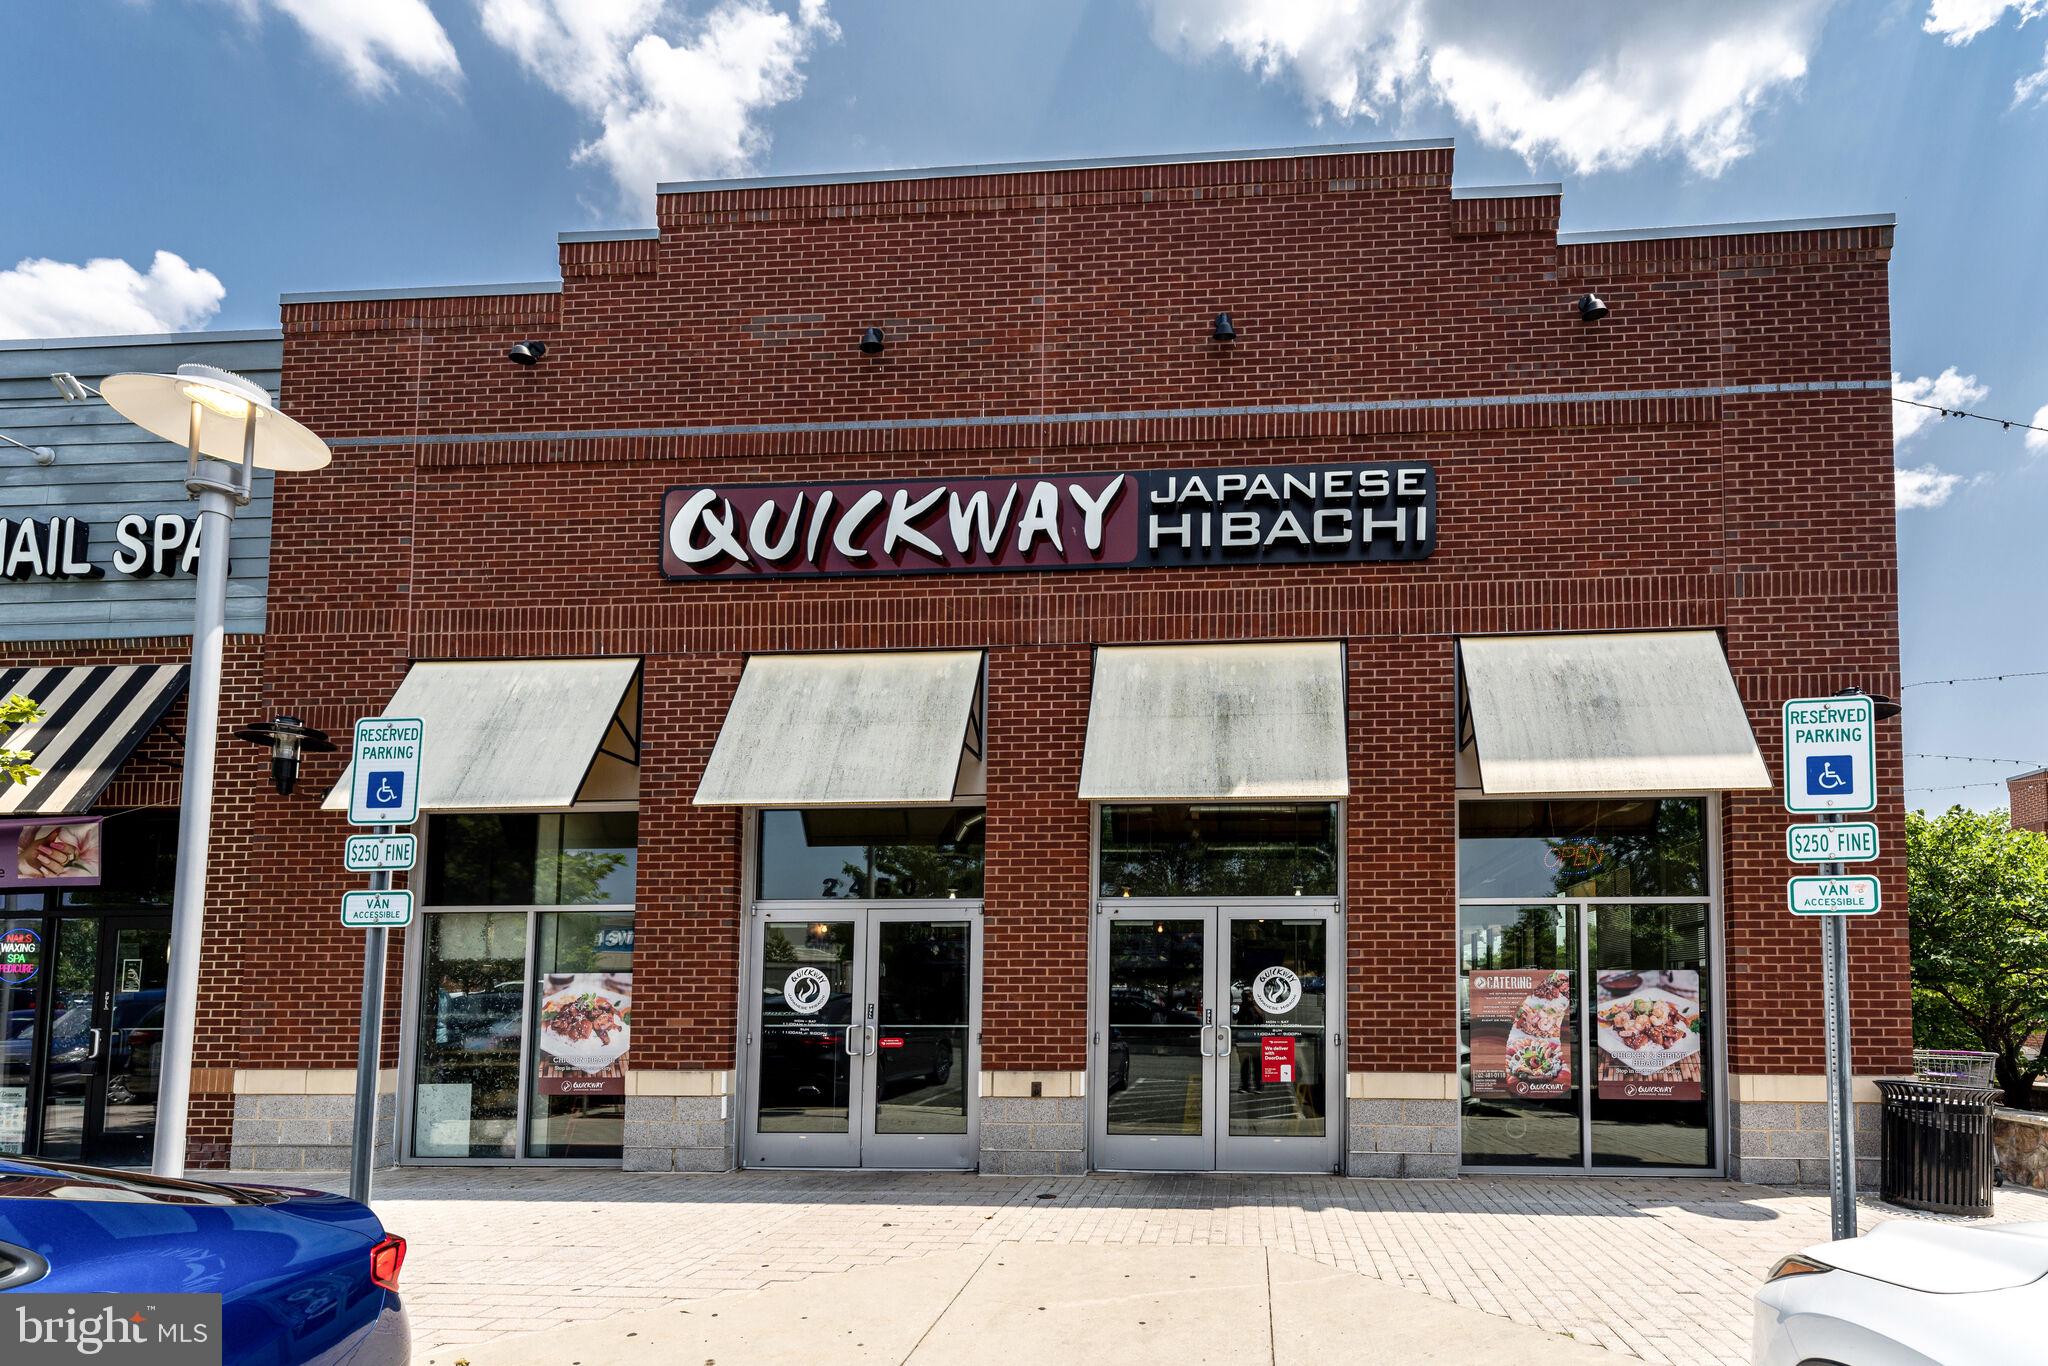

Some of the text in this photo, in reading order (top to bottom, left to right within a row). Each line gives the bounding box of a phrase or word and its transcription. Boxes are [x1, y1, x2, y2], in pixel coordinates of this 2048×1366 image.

[1151, 469, 1427, 504] JAPANESE
[669, 473, 1125, 563] QUICKWAY
[1149, 506, 1427, 548] HIBACHI
[0, 516, 92, 577] AIL
[1790, 708, 1866, 725] RESERVED
[360, 727, 418, 742] RESERVED
[1796, 728, 1862, 744] PARKING
[362, 746, 414, 760] PARKING
[1795, 832, 1871, 854] $250 FINE
[351, 843, 410, 863] $250 FINE
[1544, 845, 1605, 868] OPEN
[1818, 884, 1849, 896] VAN
[366, 898, 390, 909] VAN
[1804, 897, 1865, 906] ACCESSIBLE
[352, 910, 400, 919] ACCESSIBLE
[6, 934, 33, 943] NAILS
[1, 943, 36, 953] WAXING
[7, 953, 26, 964] SPA
[791, 968, 828, 984] QUICKWAY
[1259, 968, 1297, 983] QUICKWAY
[1486, 976, 1532, 990] CATERING
